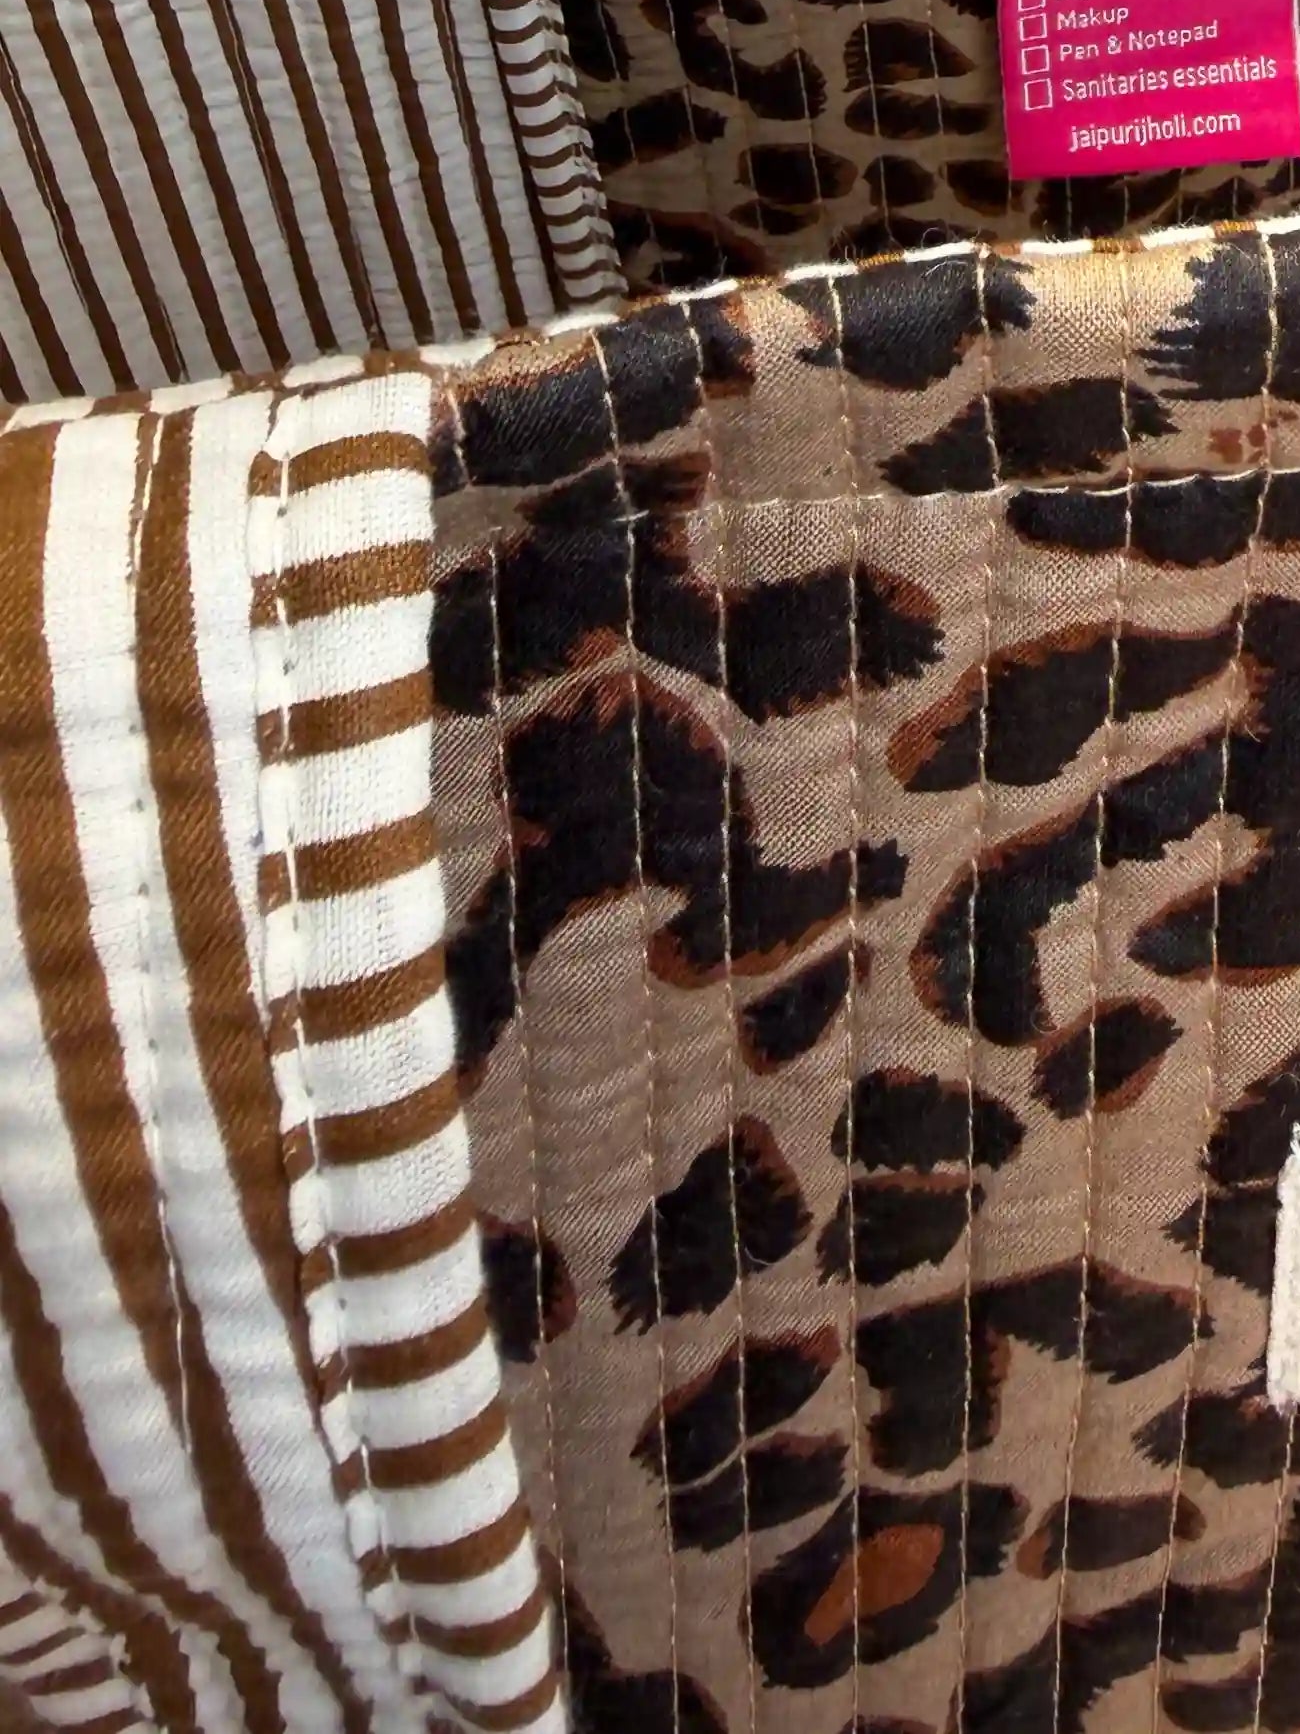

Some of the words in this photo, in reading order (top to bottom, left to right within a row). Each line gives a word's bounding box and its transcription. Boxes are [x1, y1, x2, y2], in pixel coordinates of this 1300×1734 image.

[1057, 6, 1129, 31] Makup
[1059, 42, 1099, 62] Pen
[1107, 36, 1122, 55] &
[1128, 20, 1218, 52] Notepad
[1063, 69, 1168, 102] Sanitaries
[1173, 56, 1277, 89] essentials
[1068, 113, 1241, 153] jaipurijholi.com
